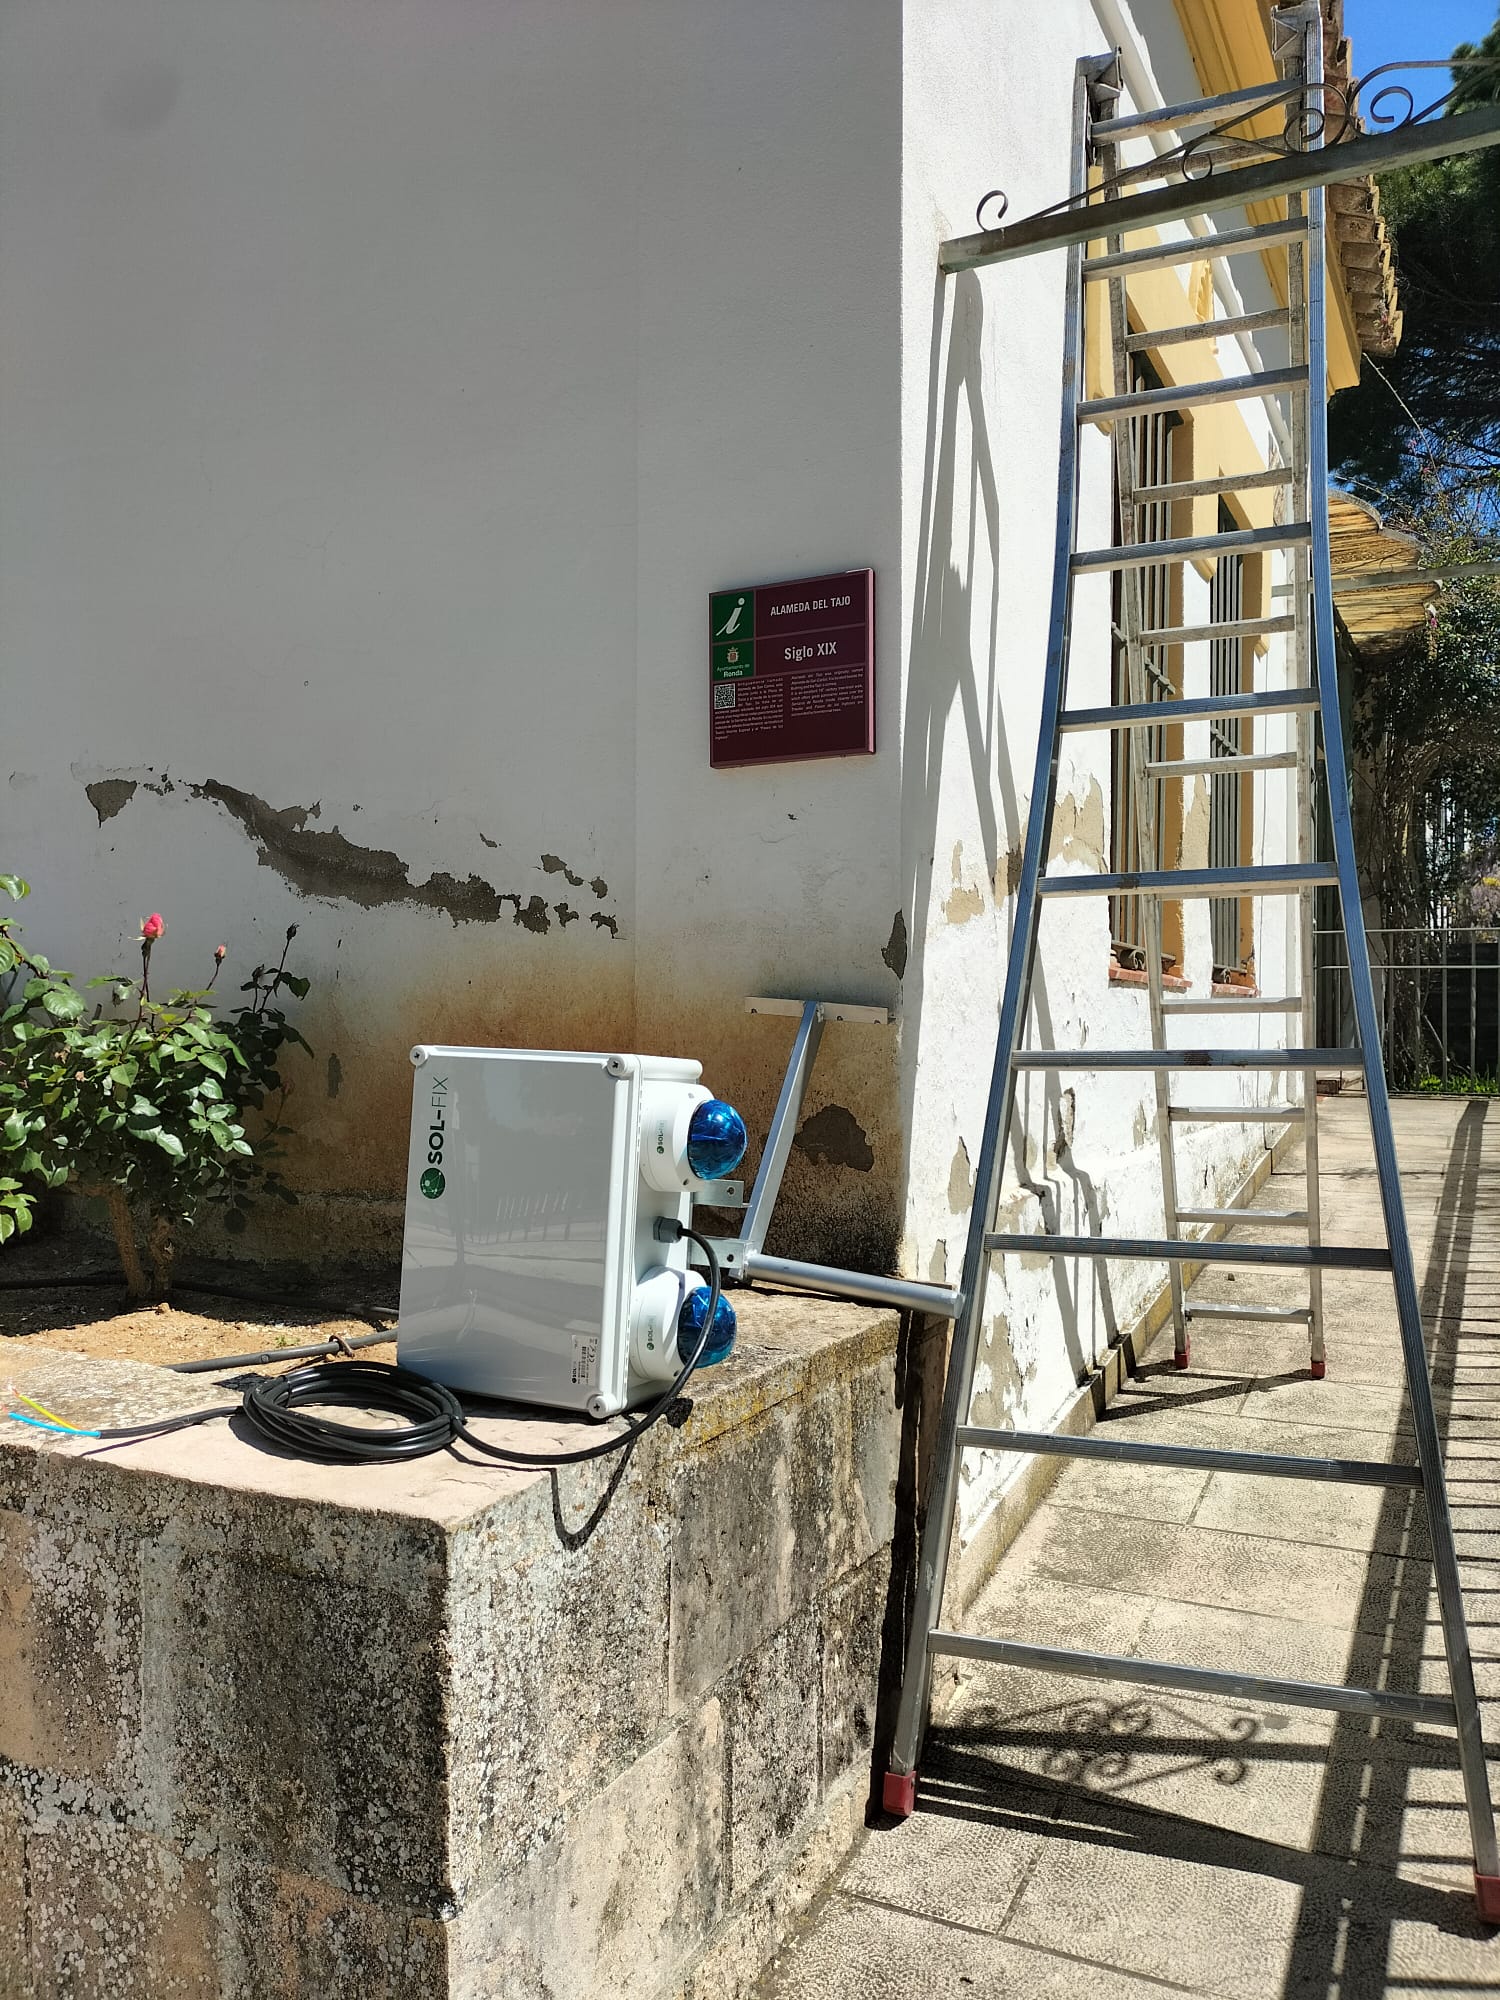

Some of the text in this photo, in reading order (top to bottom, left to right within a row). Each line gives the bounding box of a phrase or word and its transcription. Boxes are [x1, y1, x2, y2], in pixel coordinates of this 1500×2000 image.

[771, 596, 850, 616] ALAMEDA DEL TAJO
[784, 642, 836, 661] Siglo XIX
[723, 670, 743, 678] Ronda
[428, 1076, 449, 1165] SOL-FIX
